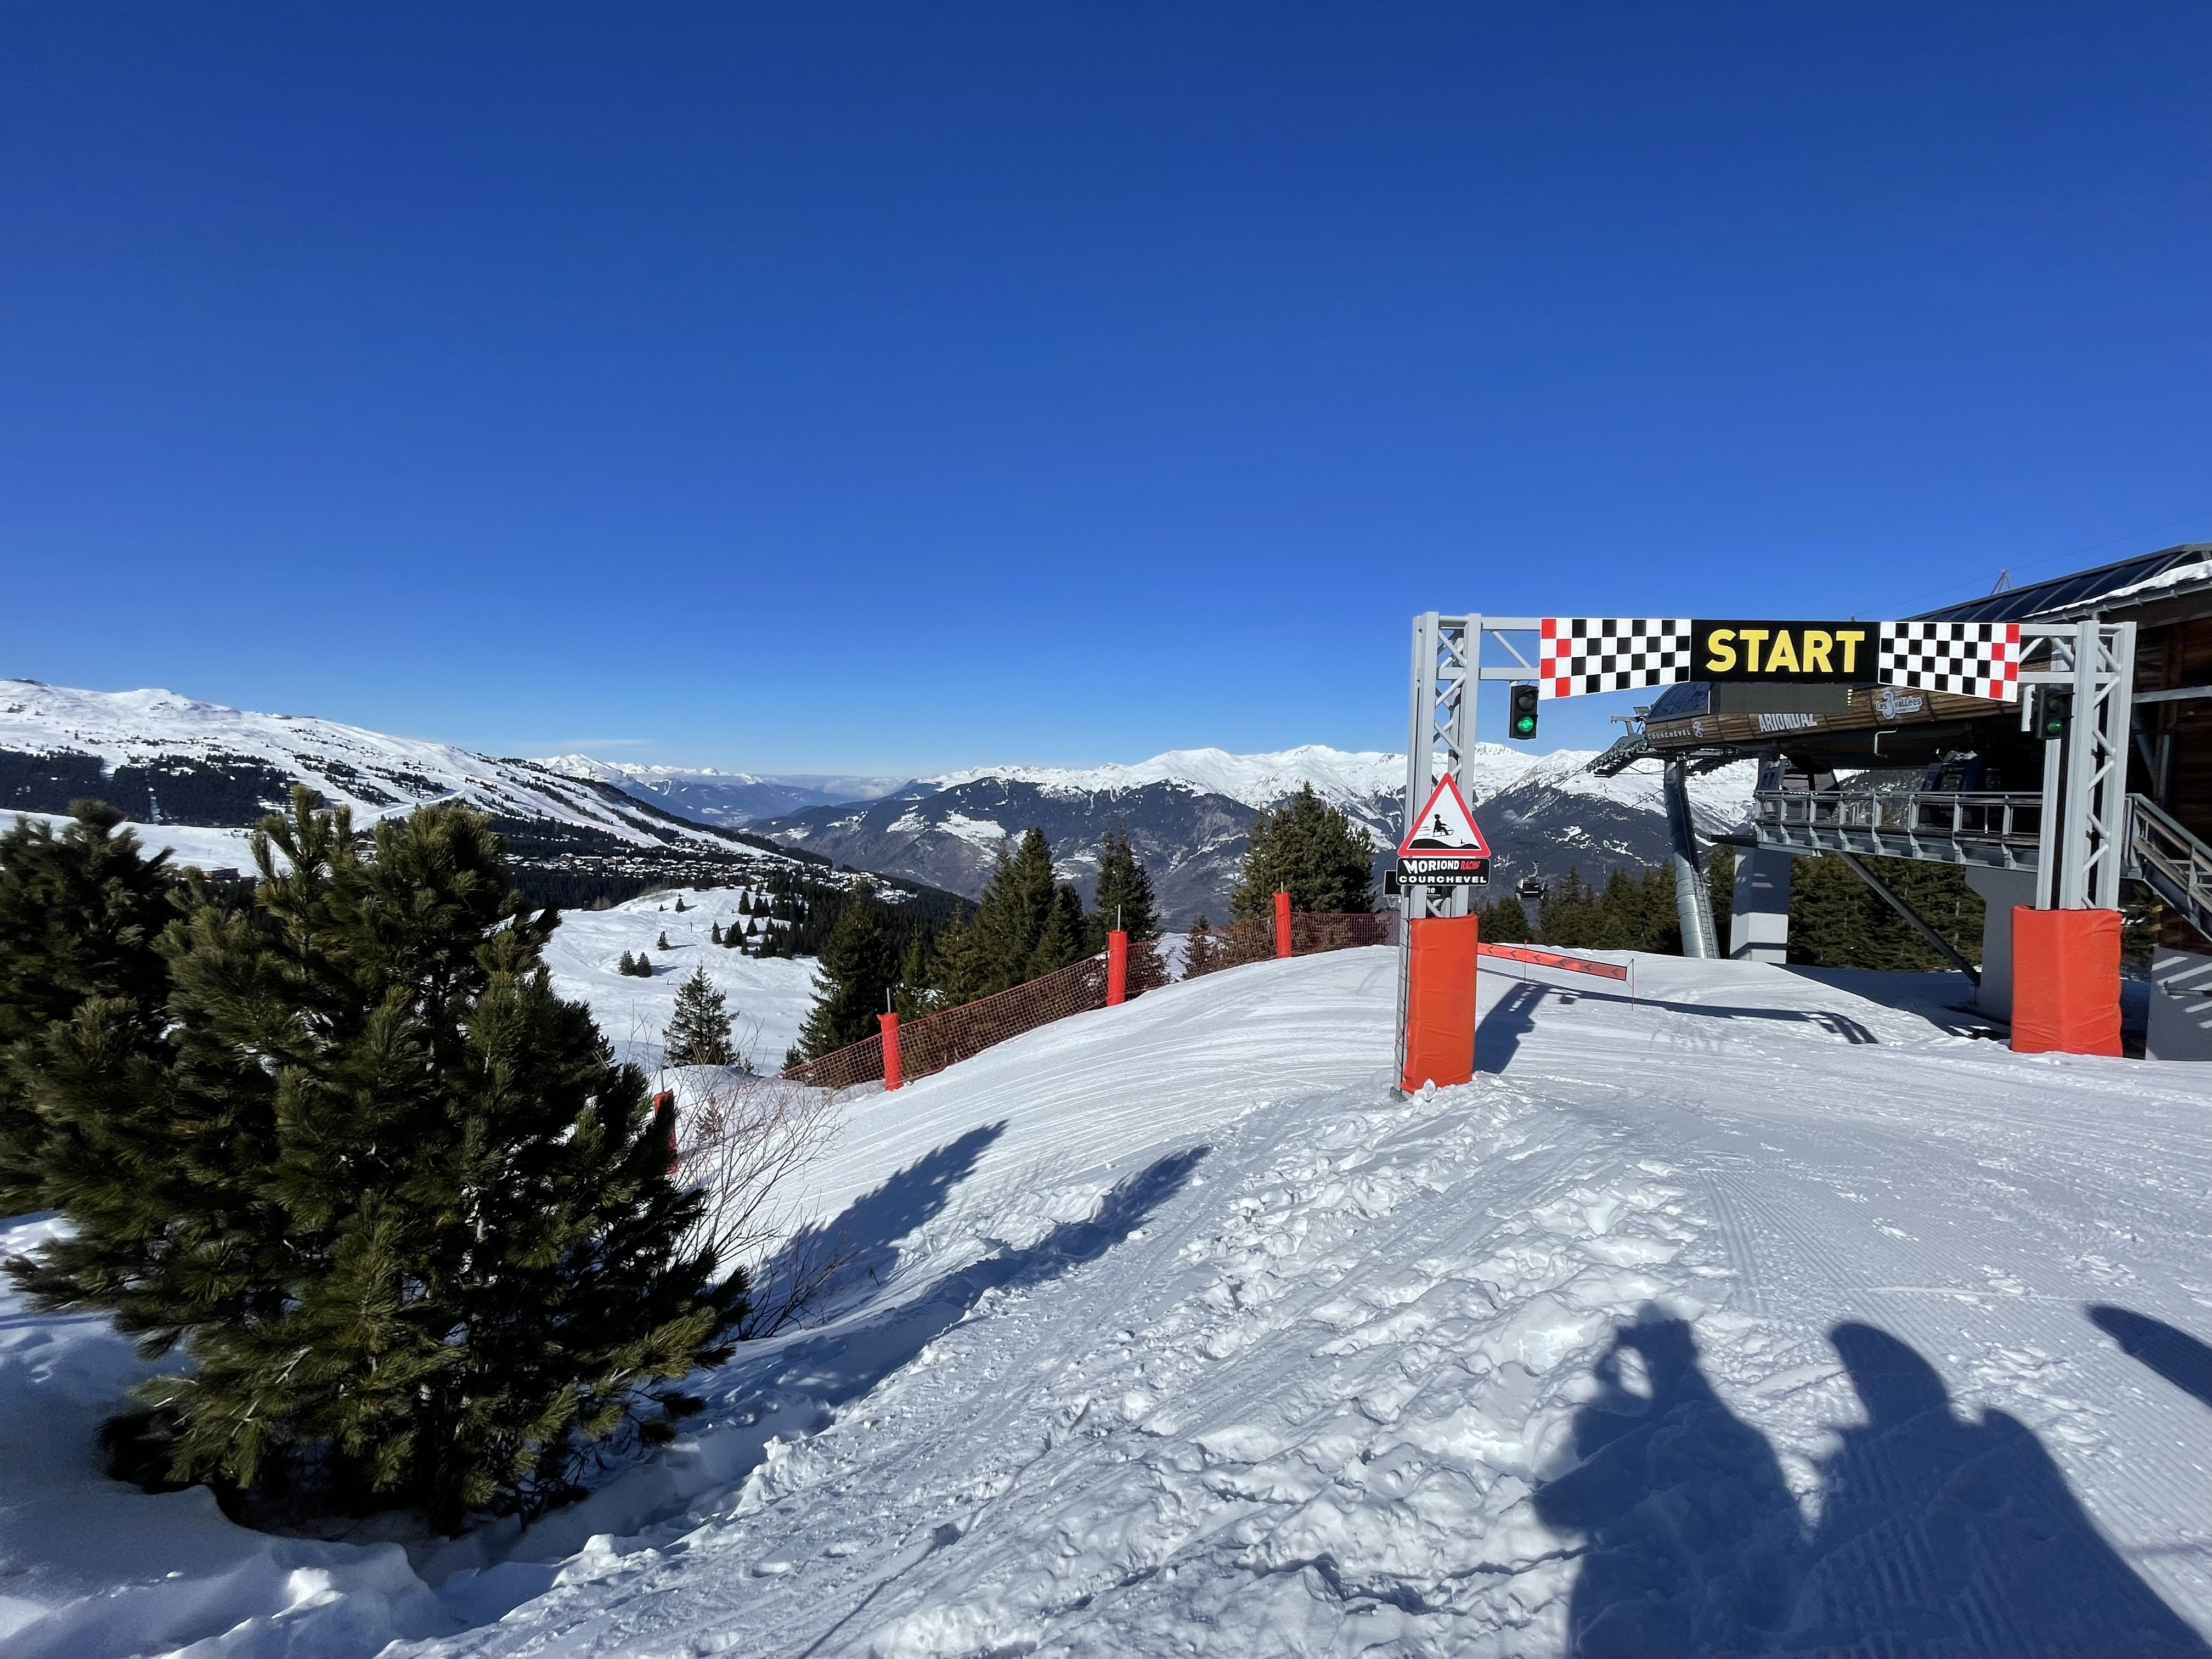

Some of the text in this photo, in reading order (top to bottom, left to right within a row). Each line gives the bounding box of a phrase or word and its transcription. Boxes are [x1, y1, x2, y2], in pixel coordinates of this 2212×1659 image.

[1706, 629, 1865, 673] START
[1647, 729, 1691, 740] COURCHEVEL
[1403, 860, 1459, 874] MORIOND
